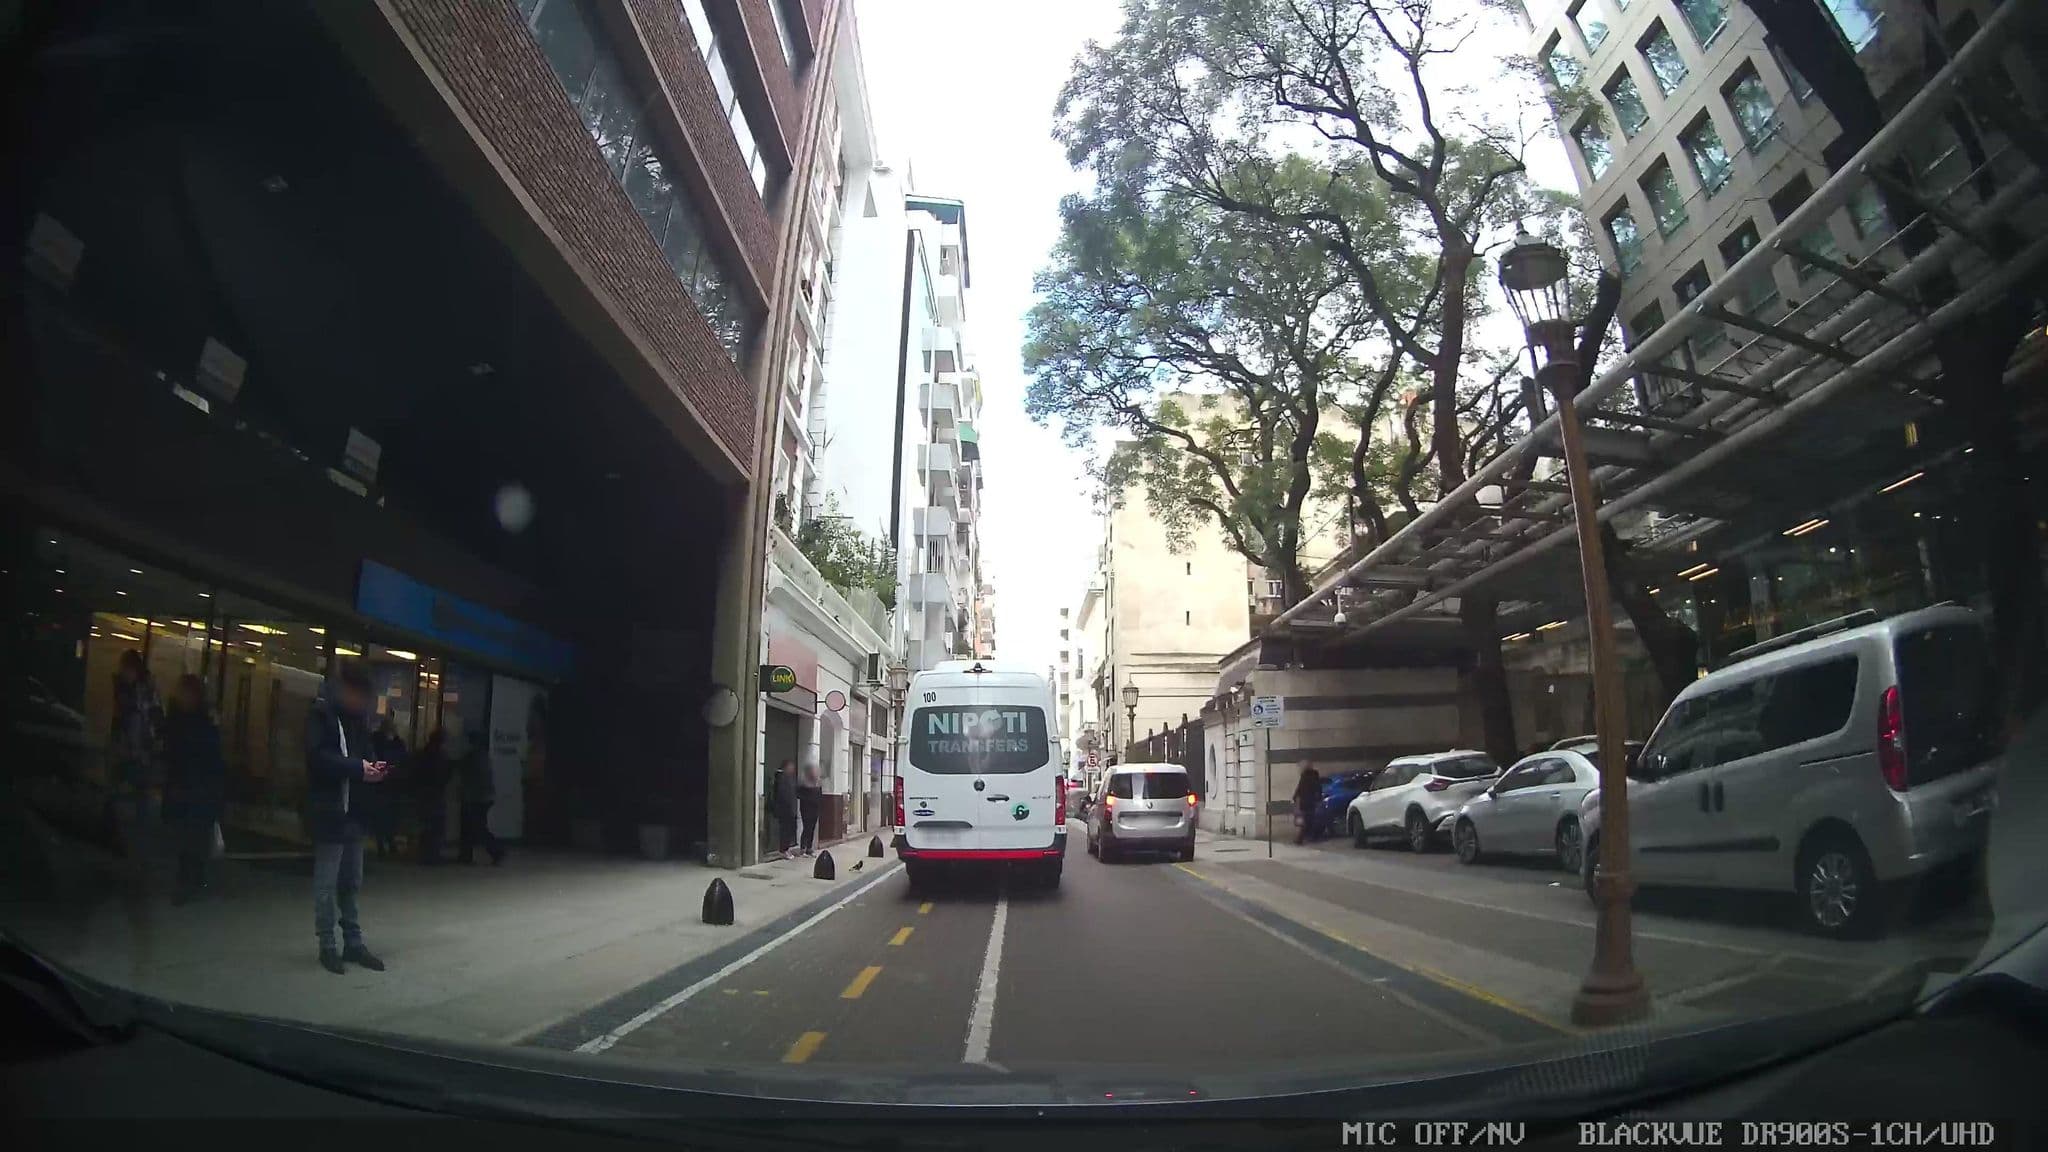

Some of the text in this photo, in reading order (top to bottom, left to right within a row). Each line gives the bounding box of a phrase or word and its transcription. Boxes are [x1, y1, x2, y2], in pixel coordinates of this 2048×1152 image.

[772, 674, 794, 683] LINK
[923, 691, 937, 703] 100
[928, 739, 1028, 753] TRANSFERS
